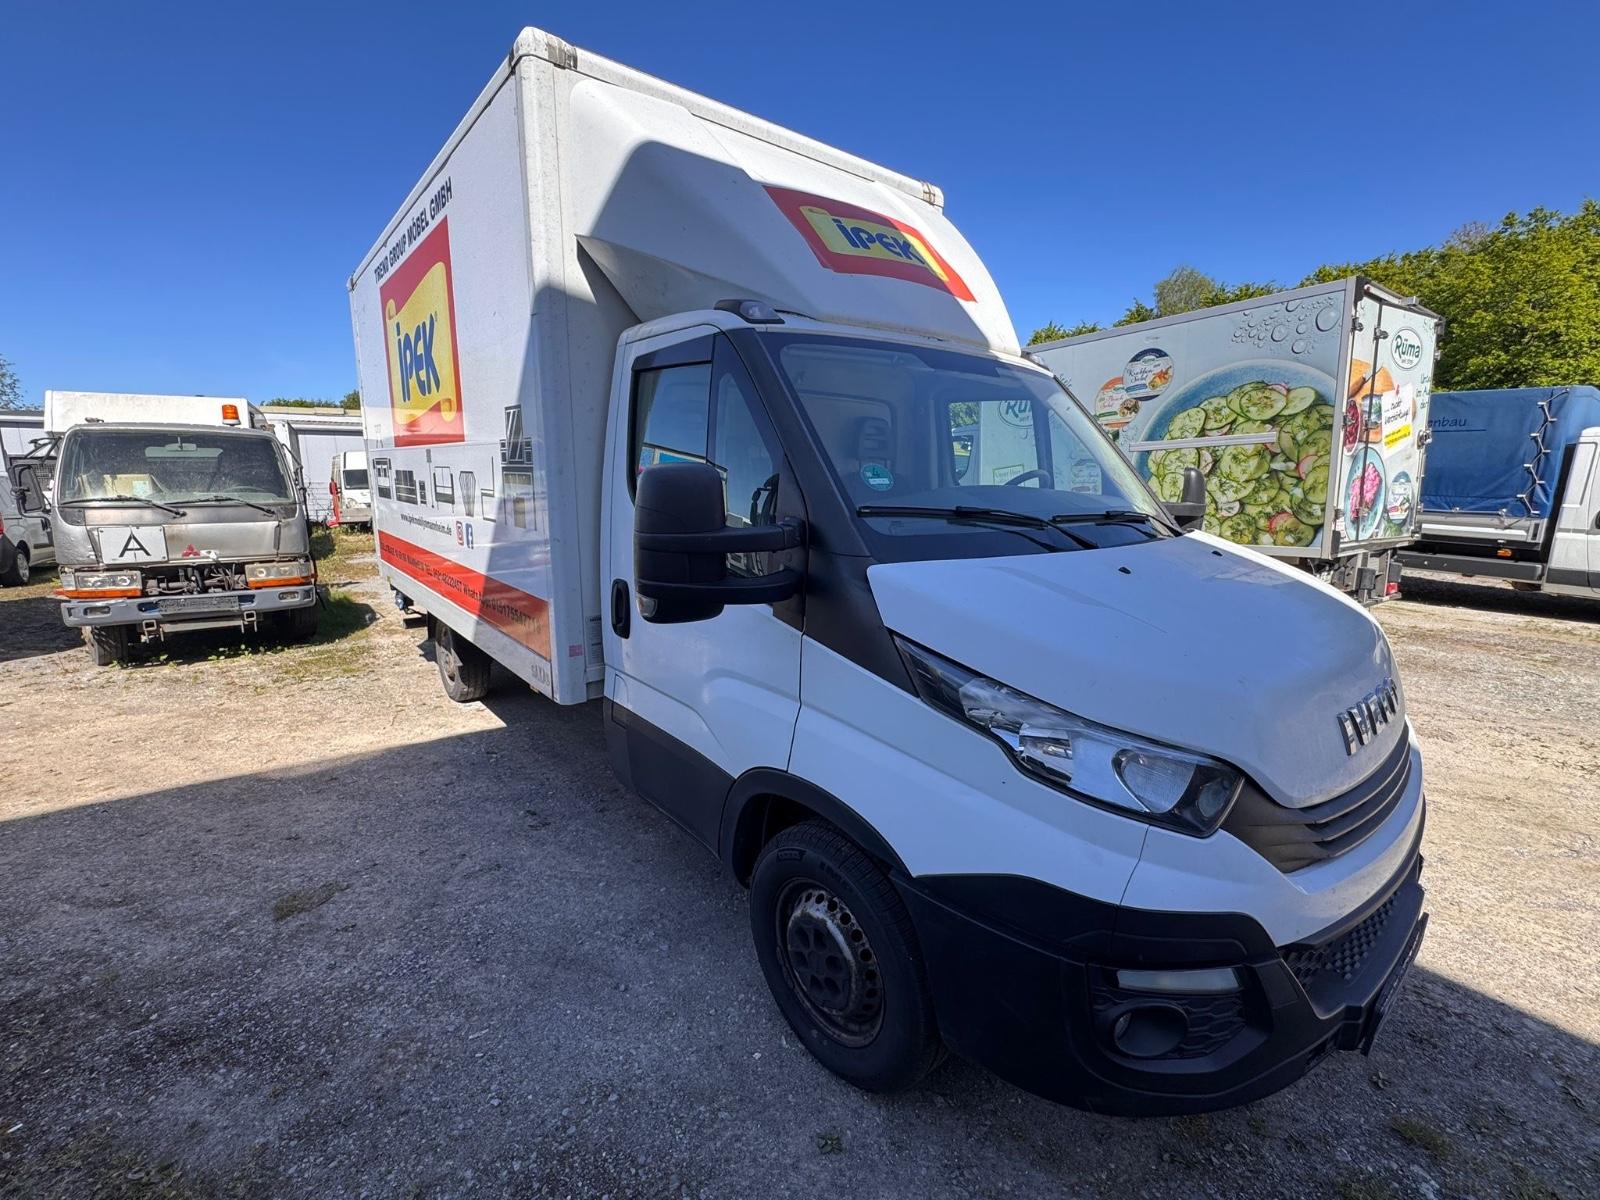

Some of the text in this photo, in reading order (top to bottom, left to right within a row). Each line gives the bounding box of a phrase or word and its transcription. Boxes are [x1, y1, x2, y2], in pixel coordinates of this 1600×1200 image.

[374, 176, 453, 284] TREND GROUP MÖBEL GMBH
[1394, 334, 1421, 359] Rüma
[119, 532, 151, 557] A
[1336, 677, 1399, 757] IVECO
